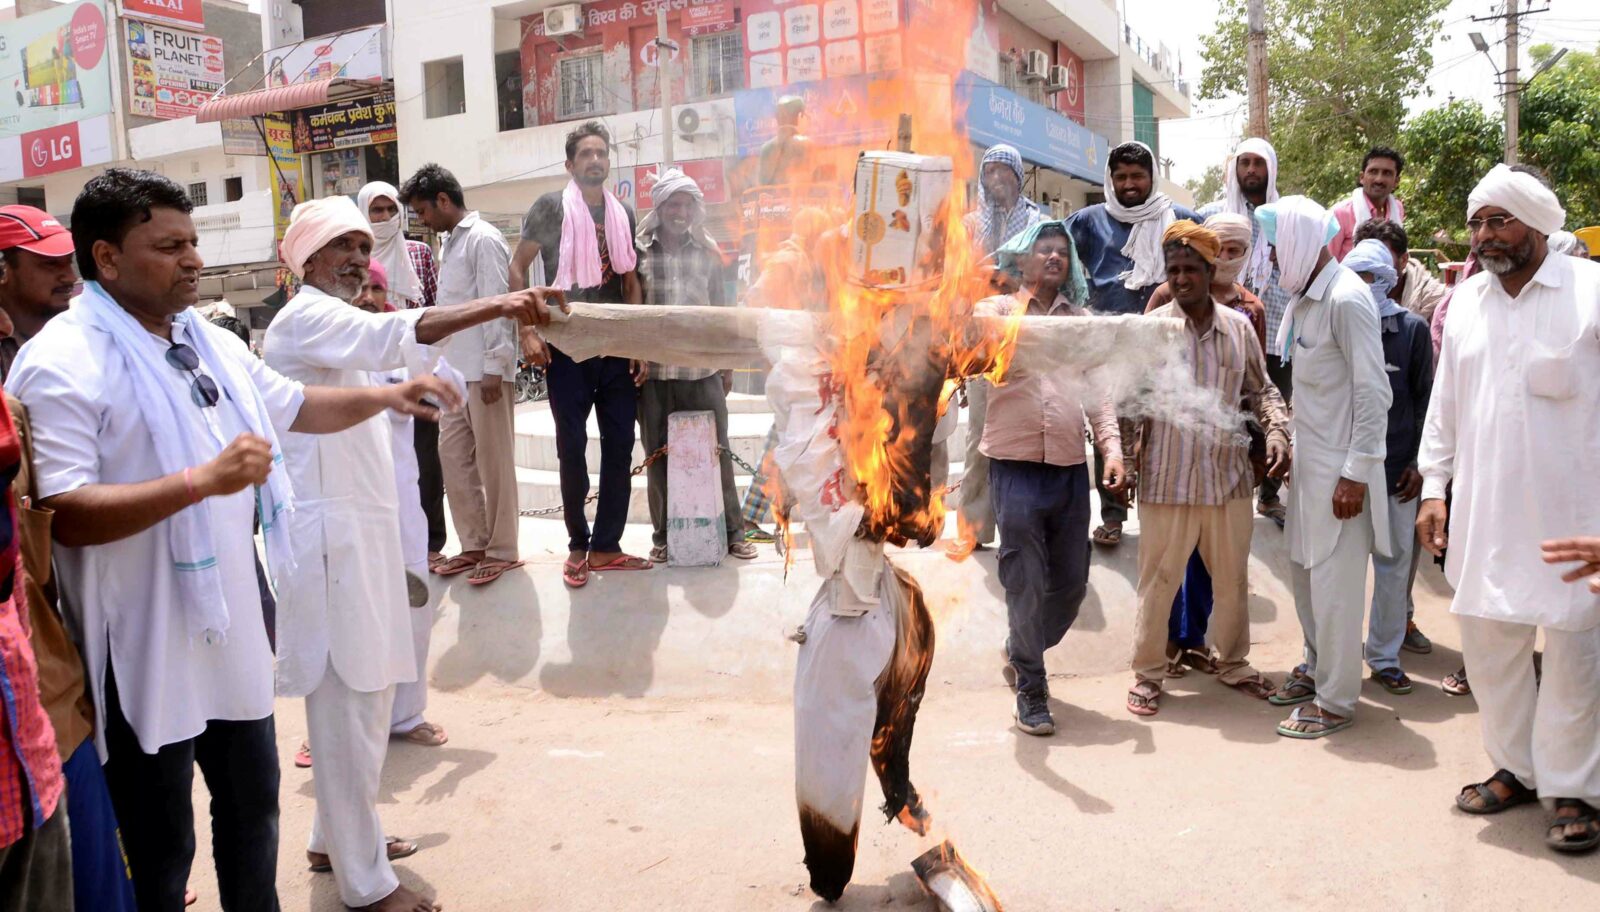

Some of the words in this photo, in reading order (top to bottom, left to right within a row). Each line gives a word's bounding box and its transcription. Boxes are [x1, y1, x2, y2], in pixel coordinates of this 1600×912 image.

[588, 8, 617, 27] विश्व
[620, 2, 638, 20] की
[153, 30, 201, 52] FRUIT
[154, 47, 203, 66] PLANET
[309, 108, 346, 127] कर्मचन्द
[347, 103, 372, 124] प्रवेश
[50, 135, 73, 161] LG
